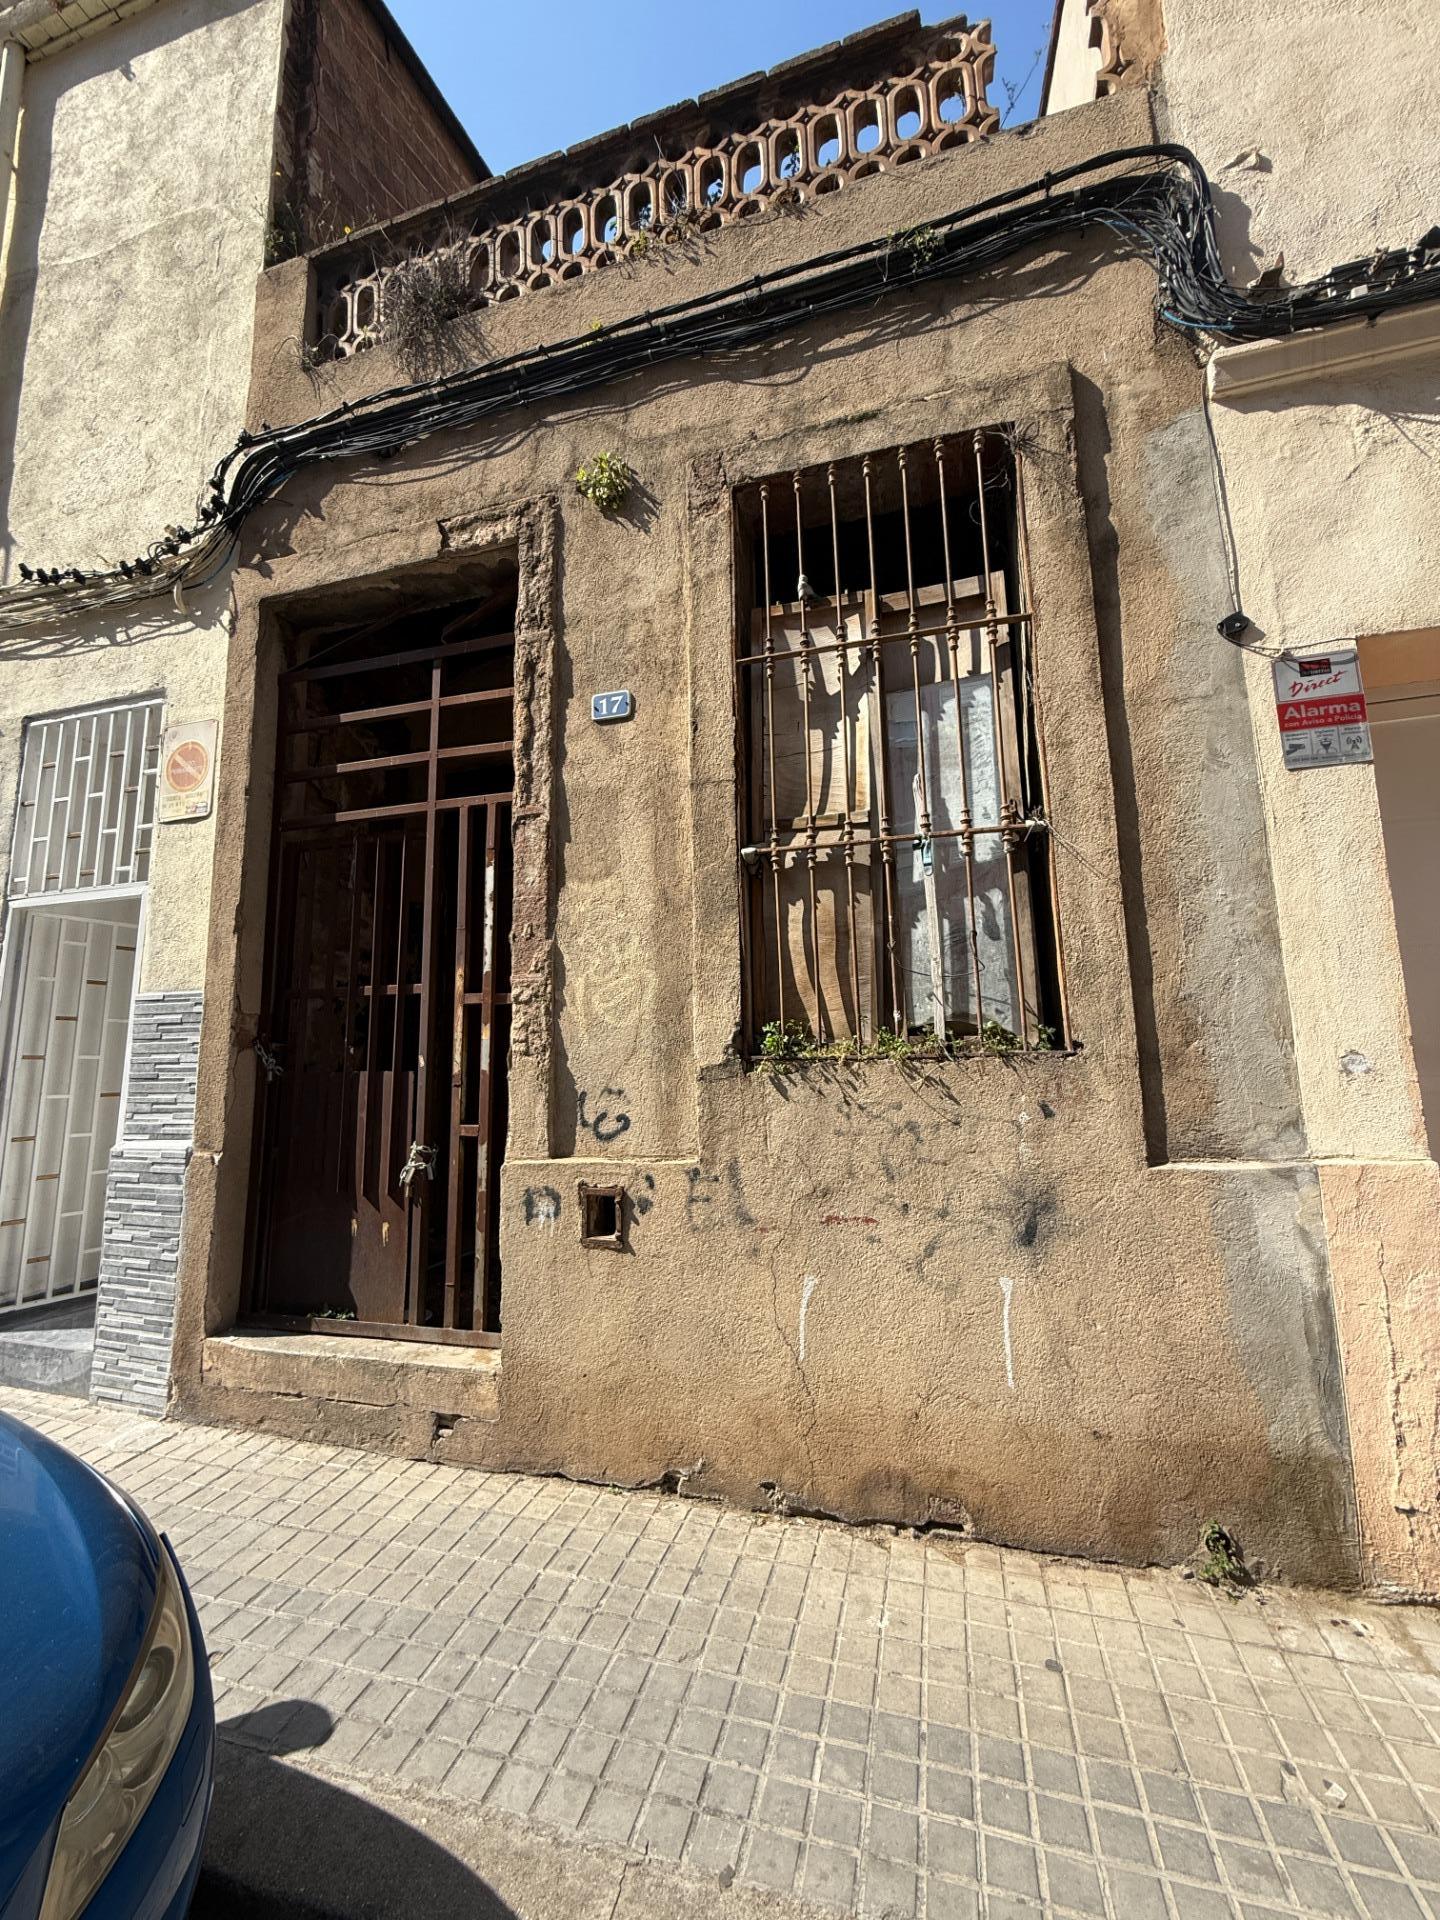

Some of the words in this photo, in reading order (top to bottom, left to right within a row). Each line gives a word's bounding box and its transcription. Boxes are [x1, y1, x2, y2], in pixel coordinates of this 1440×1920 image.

[1289, 670, 1348, 697] Direct
[600, 695, 624, 714] 17
[1284, 702, 1361, 720] Alarma
[1302, 718, 1325, 727] Aviso
